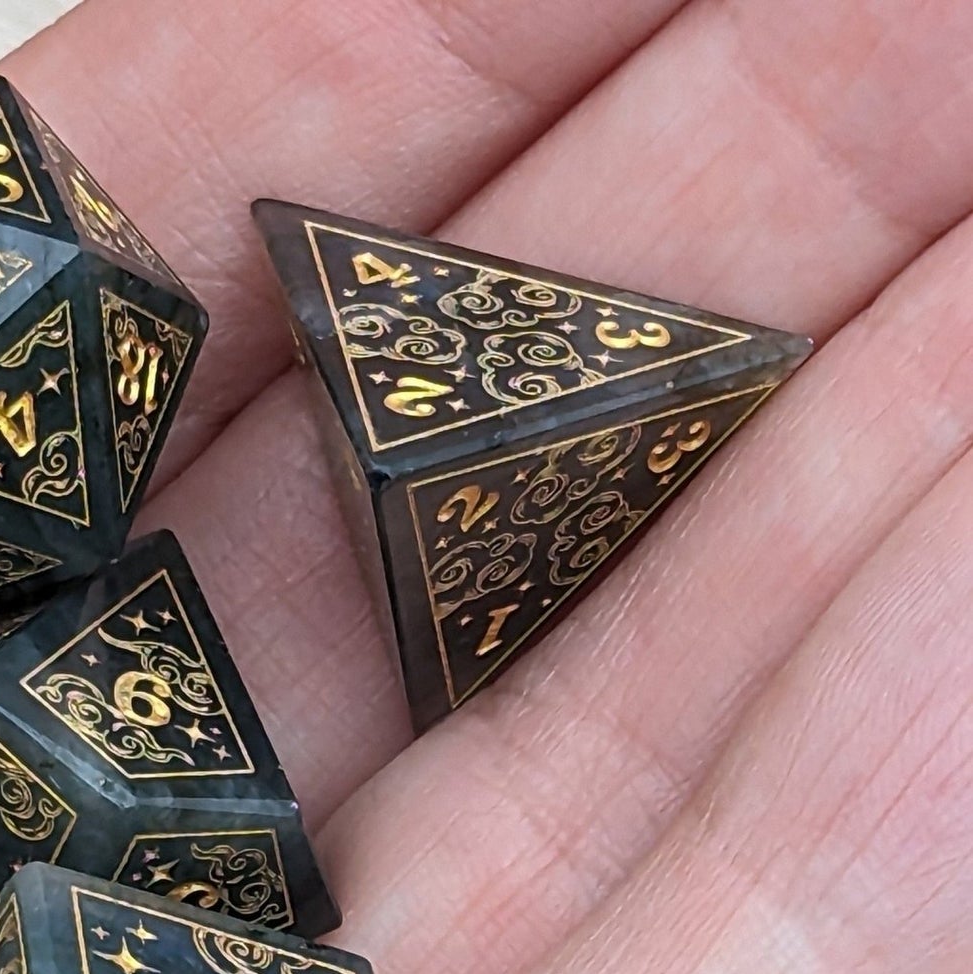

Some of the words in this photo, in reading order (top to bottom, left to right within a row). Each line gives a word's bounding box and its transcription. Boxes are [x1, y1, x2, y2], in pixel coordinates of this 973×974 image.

[352, 252, 421, 288] 4
[596, 320, 670, 349] 3
[383, 377, 454, 417] 2
[647, 421, 712, 474] 3
[437, 485, 500, 532] 2
[475, 603, 521, 657] 1
[113, 670, 171, 727] 6
